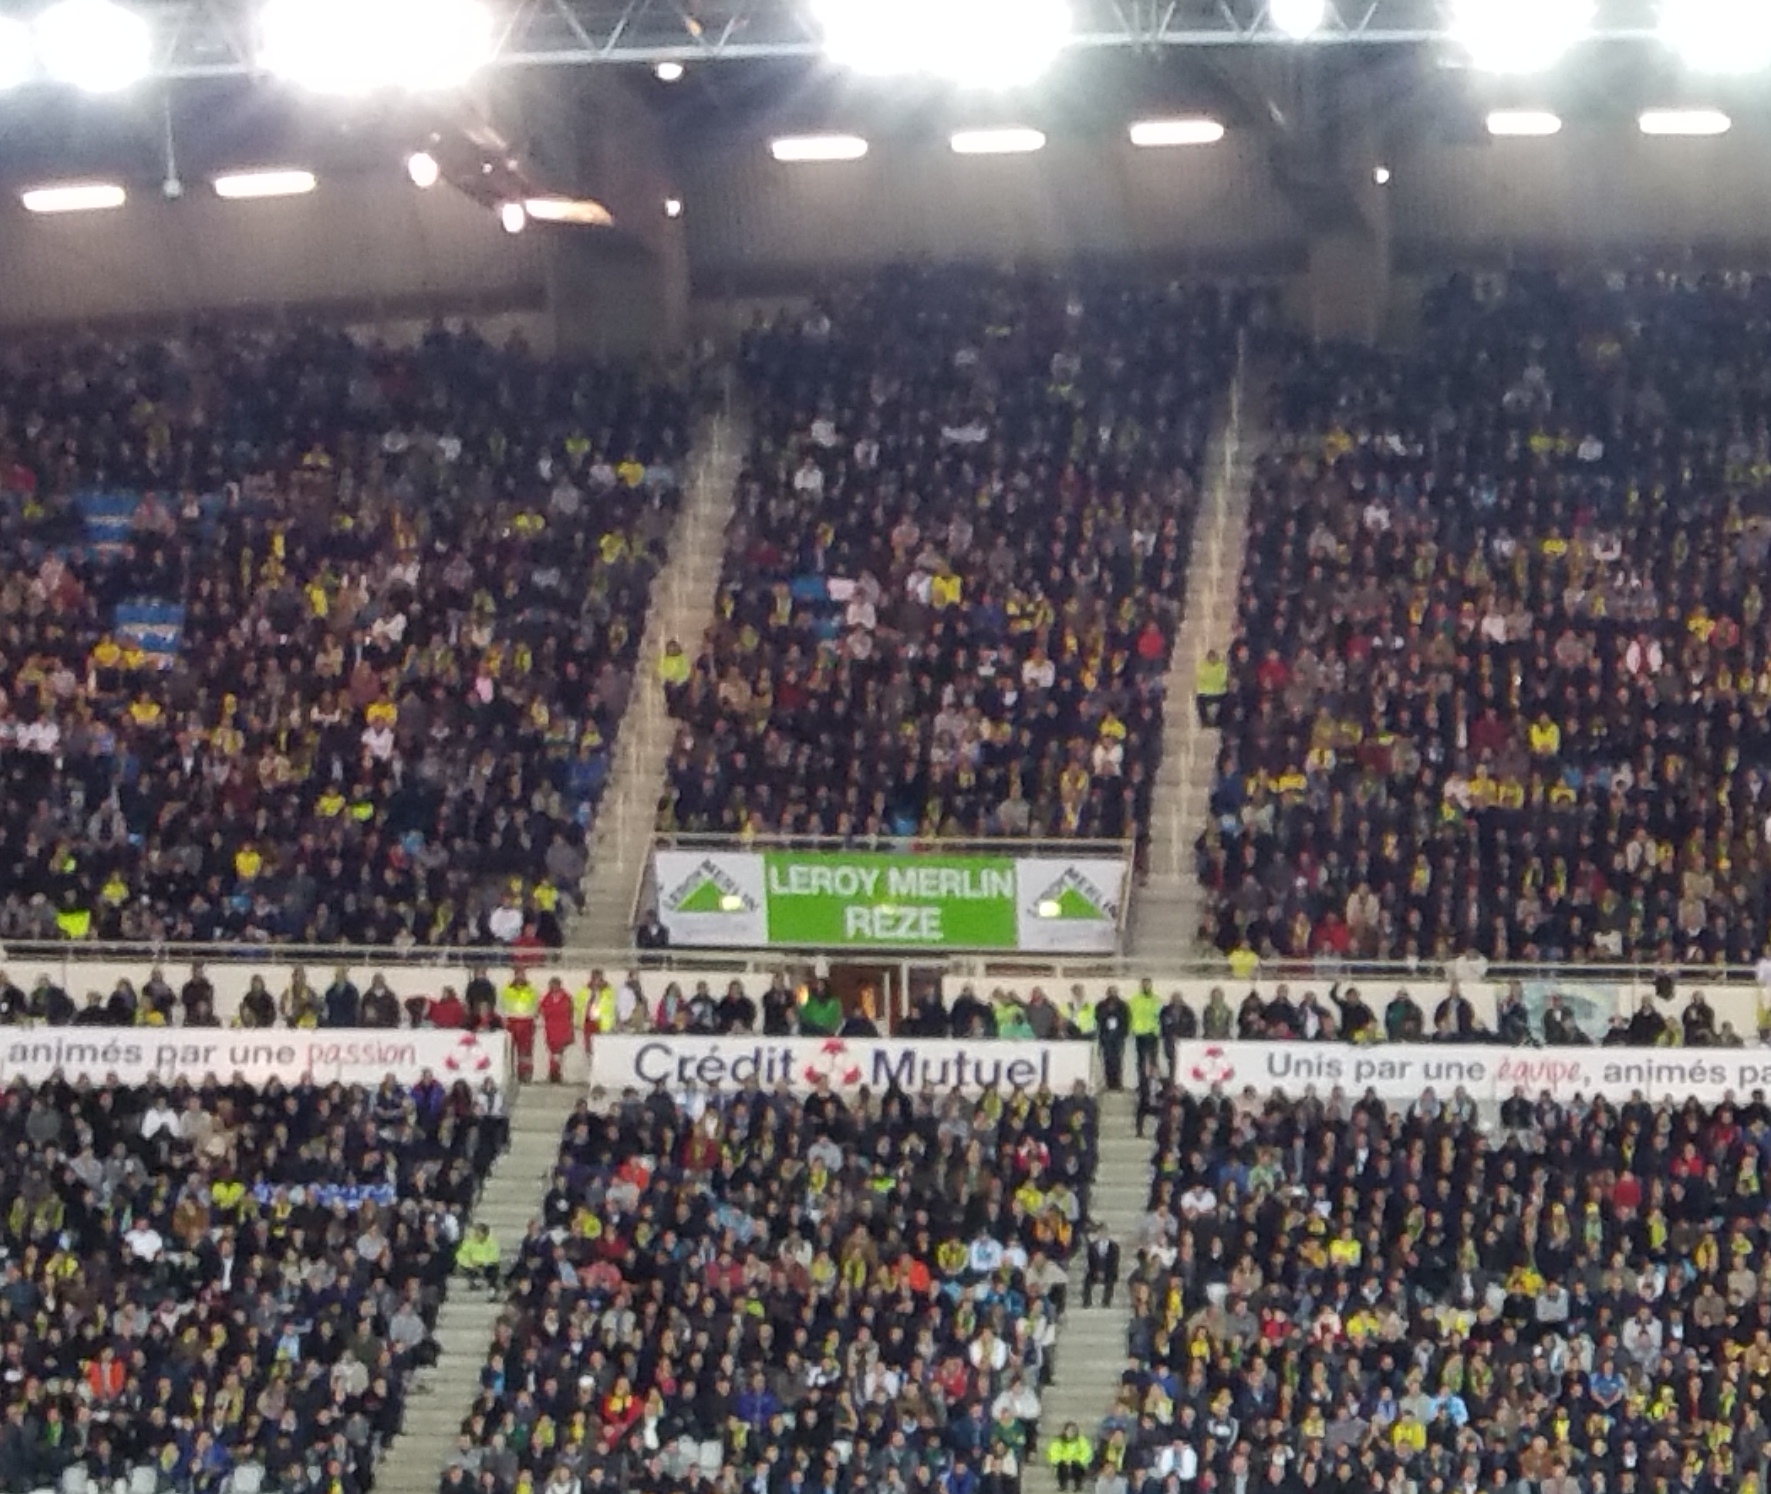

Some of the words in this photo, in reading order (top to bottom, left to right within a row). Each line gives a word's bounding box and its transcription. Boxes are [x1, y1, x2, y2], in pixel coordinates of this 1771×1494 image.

[769, 864, 879, 896] LEROY
[888, 866, 1014, 899] MERLIN
[8, 1037, 142, 1064] animés
[155, 1043, 219, 1076] par
[229, 1044, 296, 1065] une
[306, 1039, 417, 1076] passion
[634, 1042, 798, 1086] Crédit
[872, 1047, 1050, 1087] Mutuel
[1266, 1051, 1343, 1079] Unis
[1354, 1058, 1411, 1084] par
[1424, 1059, 1486, 1081] une
[1604, 1057, 1726, 1085] animés
